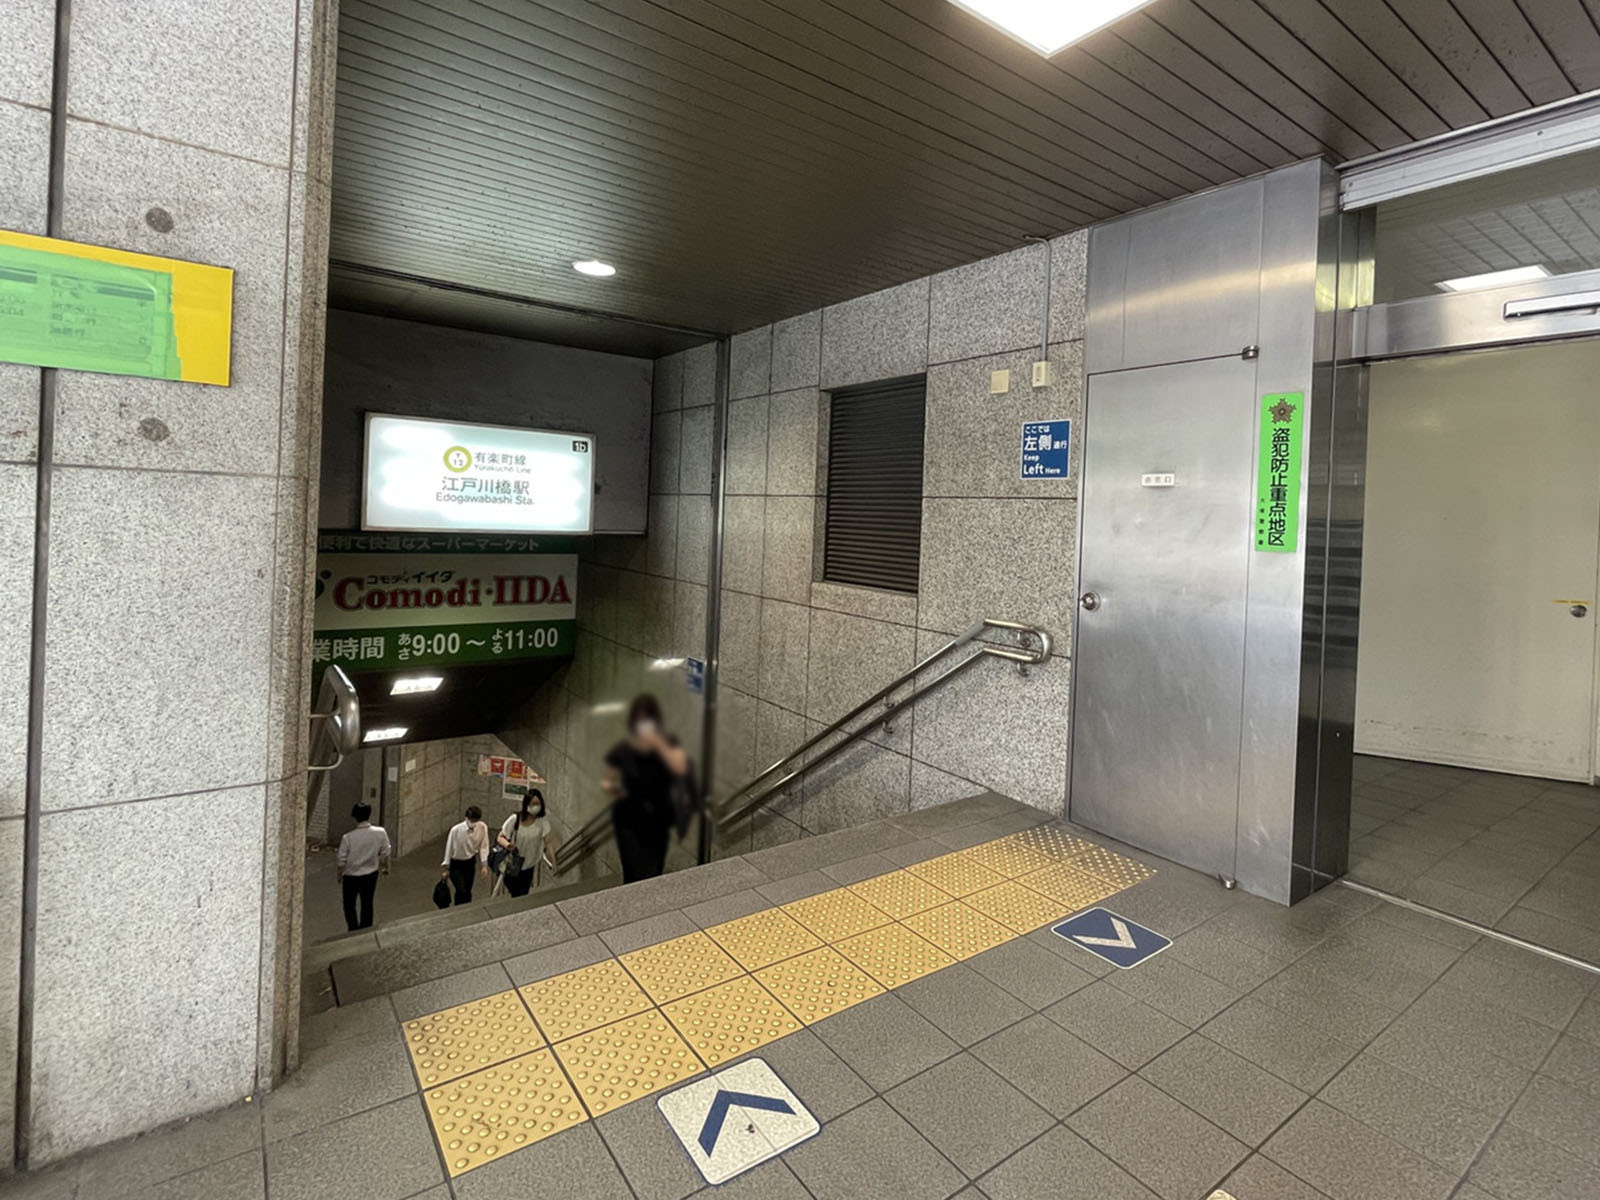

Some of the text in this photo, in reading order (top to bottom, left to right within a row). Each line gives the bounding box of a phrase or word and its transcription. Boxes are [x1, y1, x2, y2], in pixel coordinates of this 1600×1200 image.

[1024, 425, 1051, 434] ここでは
[574, 441, 588, 452] 1b
[1023, 435, 1052, 451] 左側
[474, 451, 527, 465] 有楽町線
[1024, 454, 1040, 462] Keep
[1023, 463, 1061, 475] Left Here
[441, 475, 531, 495] 江戸川橋駅
[1267, 427, 1291, 547] 盗犯防止重点地区
[435, 492, 536, 505] Edogawabashi Sta.
[366, 570, 455, 585] コモディイイダ
